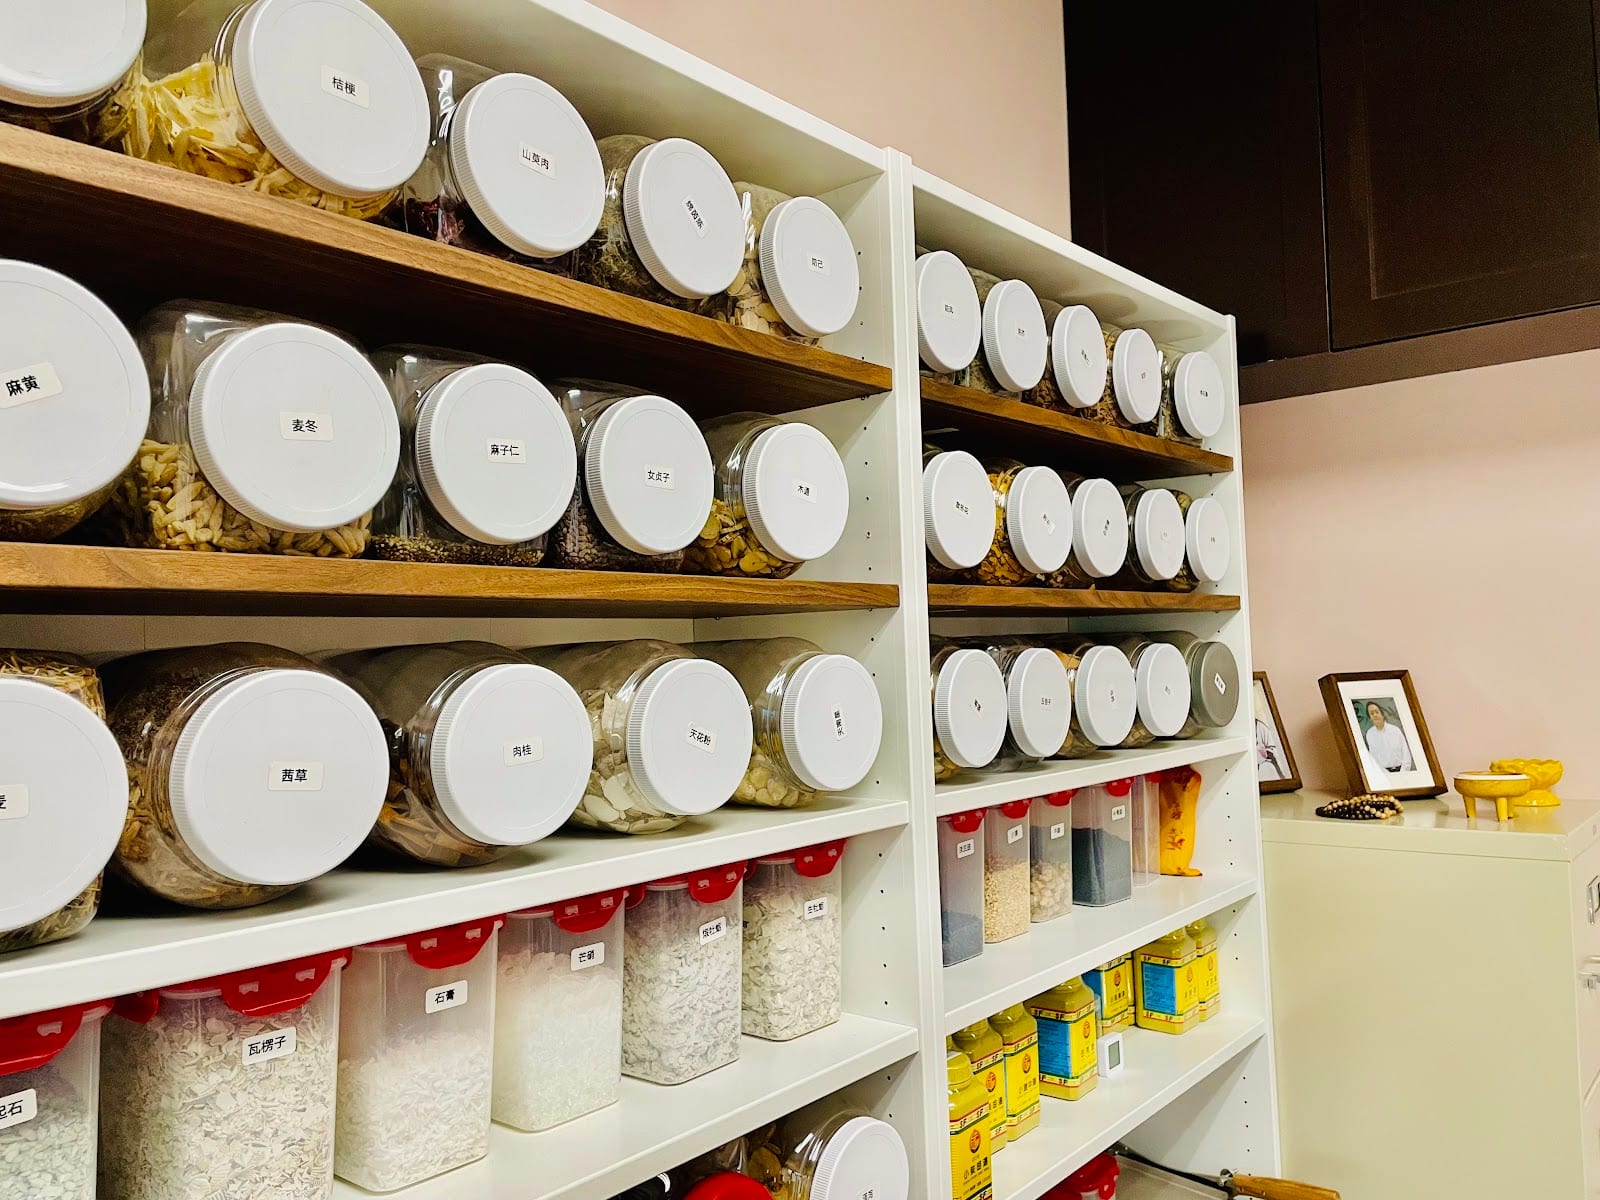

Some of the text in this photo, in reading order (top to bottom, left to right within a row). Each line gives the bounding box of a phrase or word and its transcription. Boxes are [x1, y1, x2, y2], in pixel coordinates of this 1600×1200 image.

[332, 76, 357, 97] 桔梗
[6, 374, 40, 396] 麻黄
[292, 418, 318, 433] 麦冬
[490, 444, 520, 456] 麻子仁
[647, 469, 670, 483] 女贞子
[689, 728, 711, 746] 天花粉
[512, 744, 532, 757] 肉桂
[282, 768, 308, 783] 茜草
[578, 949, 594, 963] 芒硝
[434, 988, 455, 1004] 石膏
[248, 1035, 287, 1057] 瓦楞子
